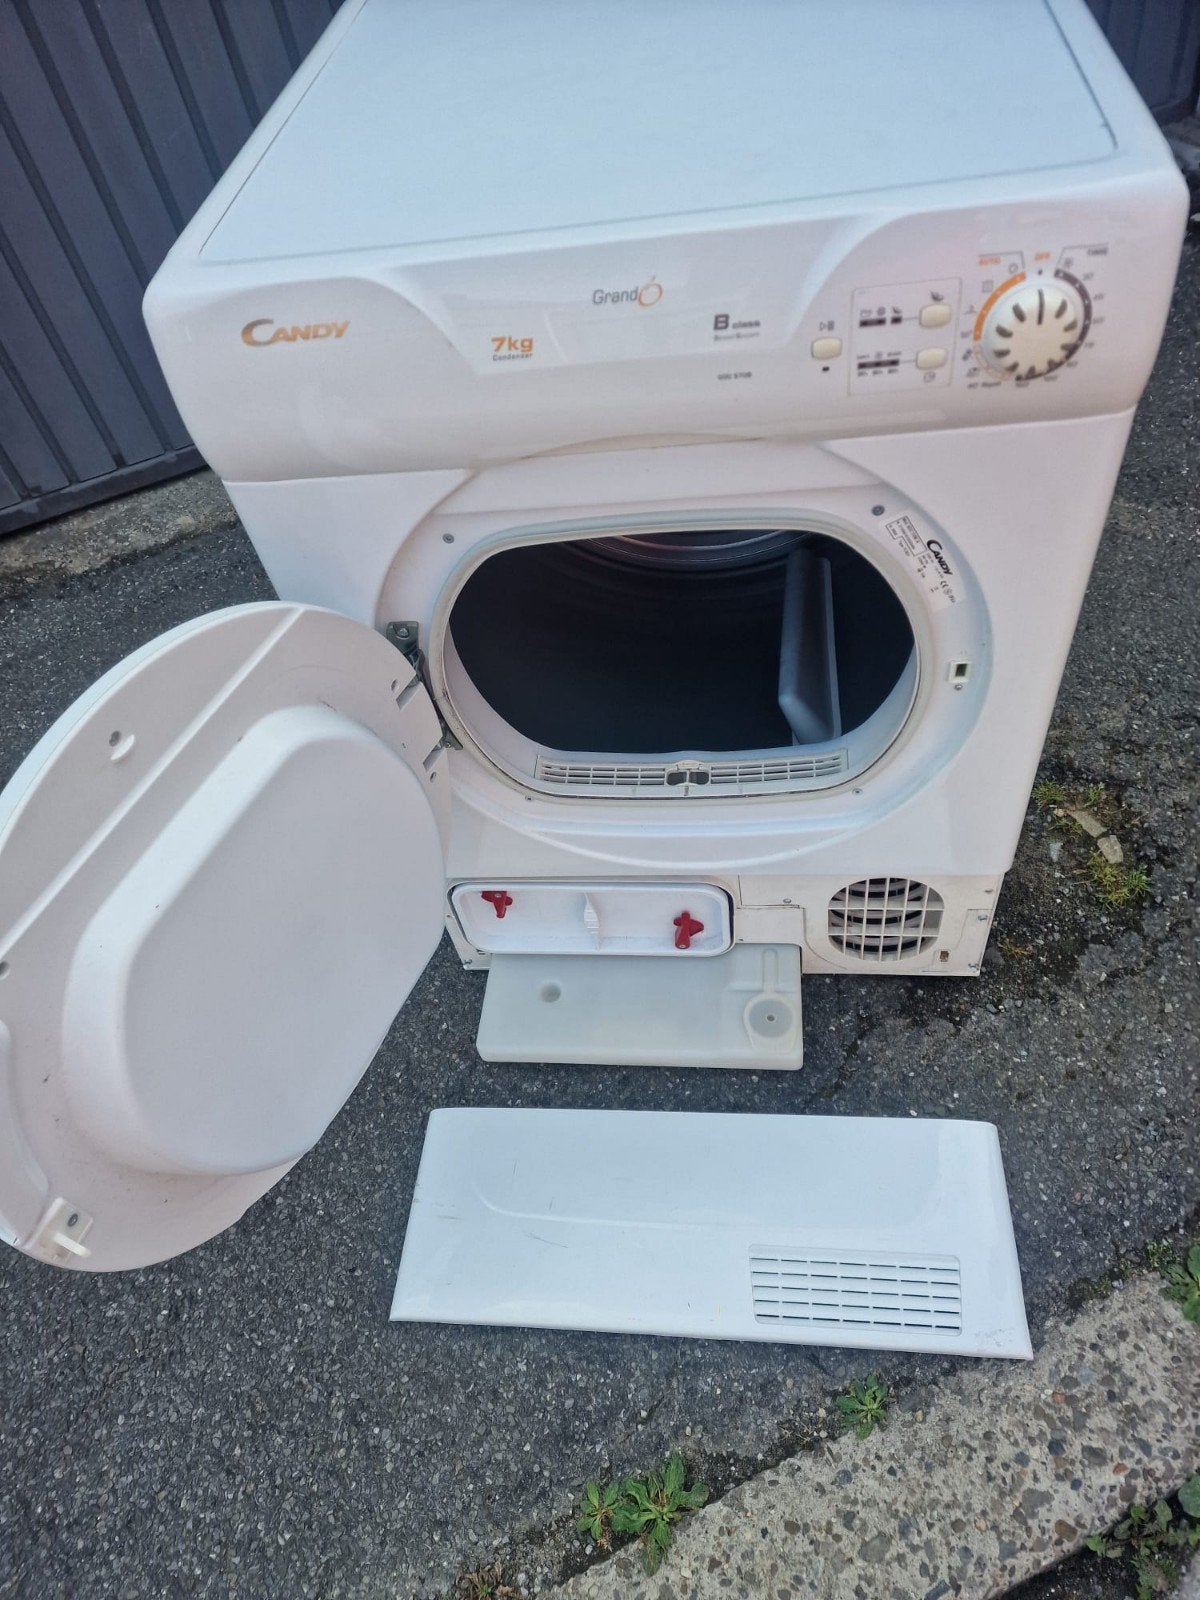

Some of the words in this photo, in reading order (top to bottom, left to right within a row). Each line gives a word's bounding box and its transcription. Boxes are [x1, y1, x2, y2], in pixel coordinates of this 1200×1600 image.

[241, 318, 350, 347] CANDY
[713, 314, 730, 331] B
[491, 335, 533, 353] 7kg
[926, 539, 953, 575] CANDY
